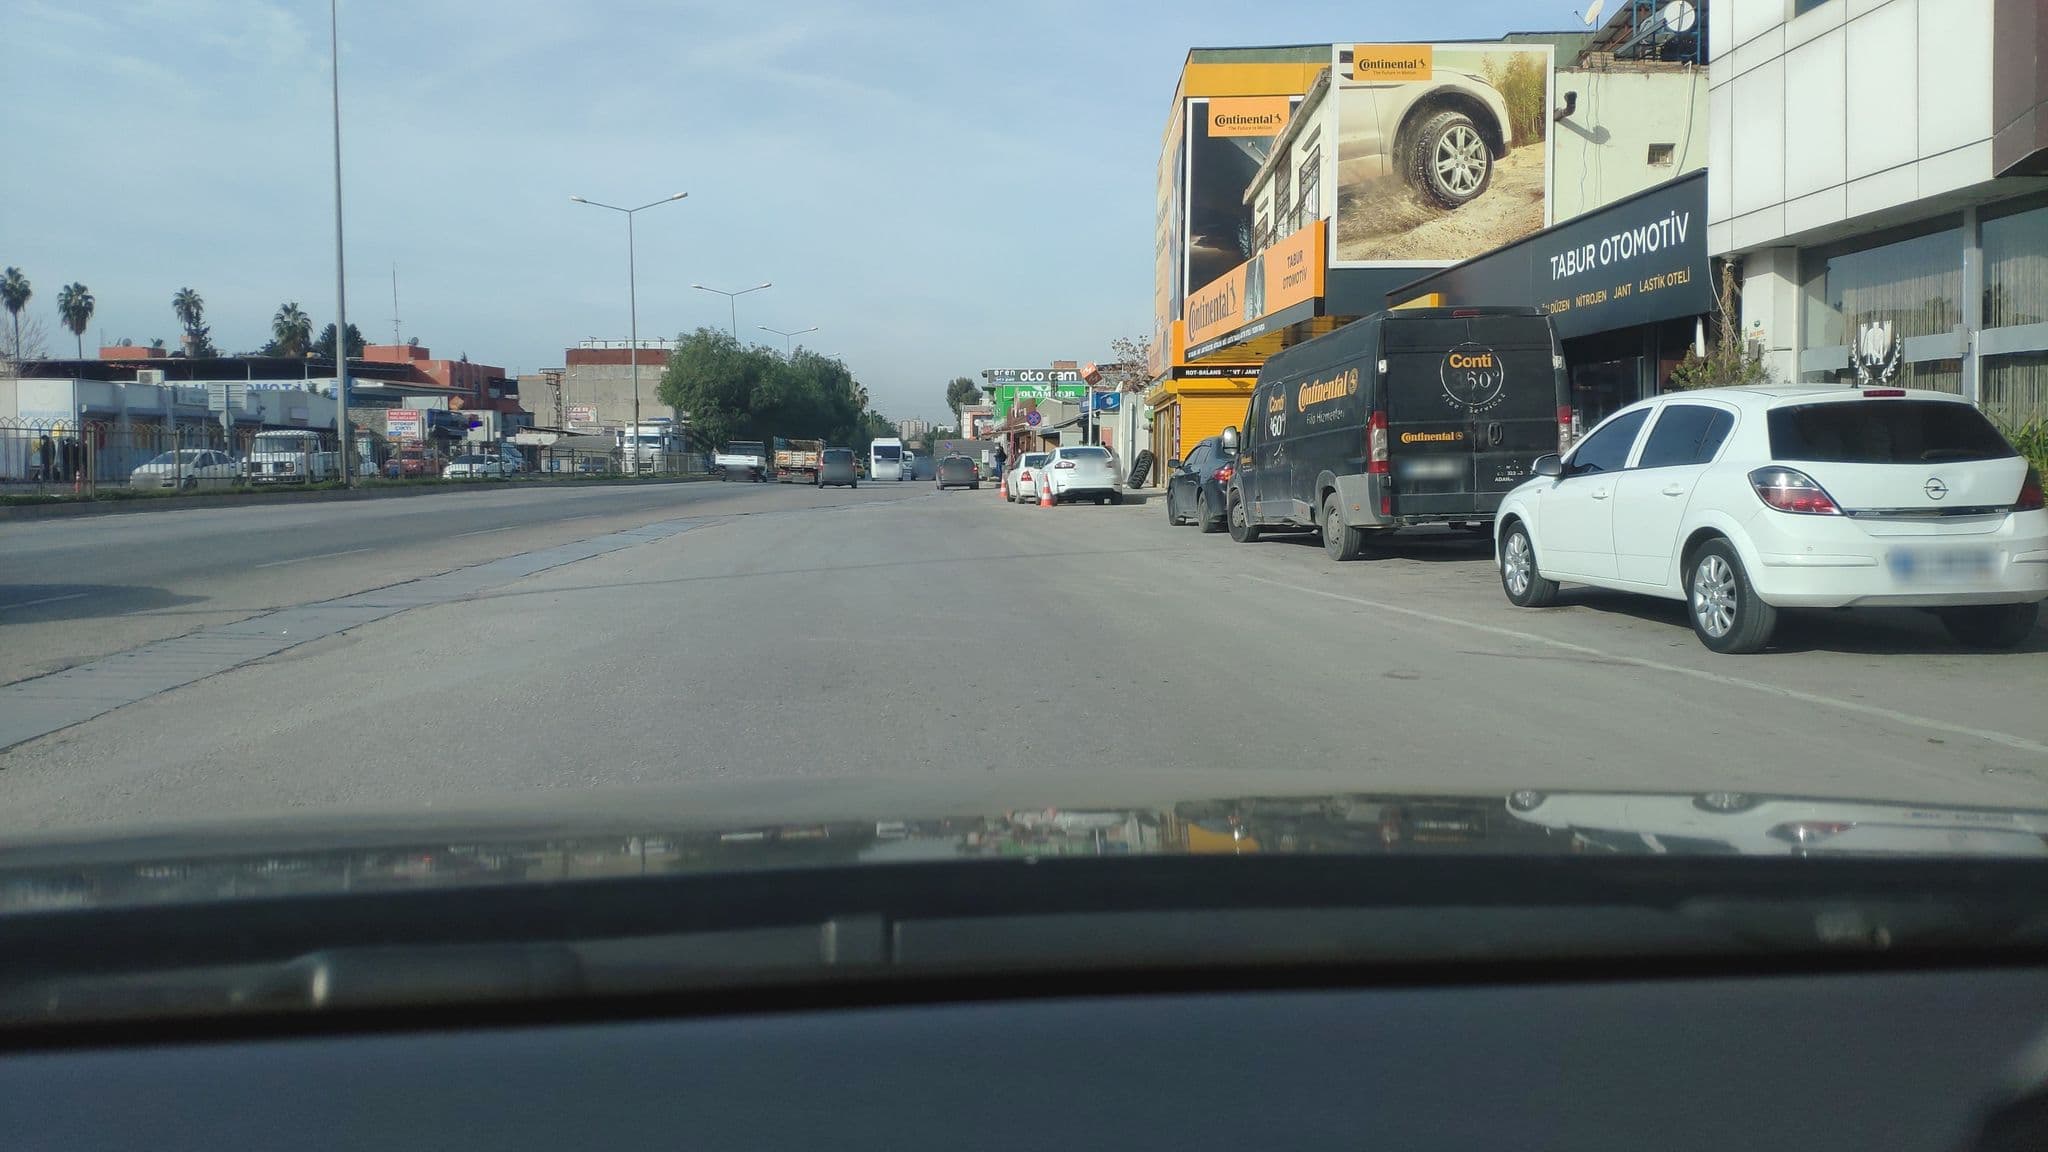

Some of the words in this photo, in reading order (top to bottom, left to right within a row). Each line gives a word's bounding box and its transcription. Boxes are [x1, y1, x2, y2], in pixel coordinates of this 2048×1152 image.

[1359, 58, 1417, 72] Continental
[1215, 114, 1273, 127] Continental
[1551, 243, 1595, 281] TABUR
[1600, 210, 1689, 266] OTOMOTİV
[1287, 250, 1303, 269] TABUR
[1551, 299, 1570, 314] DÜZEN
[1576, 289, 1607, 308] NİTROJEN
[1613, 283, 1632, 299] JANT
[1639, 273, 1666, 293] LASTİK
[1667, 266, 1691, 286] OTELİ
[1188, 281, 1230, 342] Continental
[1449, 353, 1492, 368] Conti
[1020, 369, 1044, 381] oto
[1048, 371, 1077, 381] cam
[1298, 370, 1349, 413] Continental
[1269, 394, 1285, 413] Conti
[1401, 431, 1455, 444] Continental
